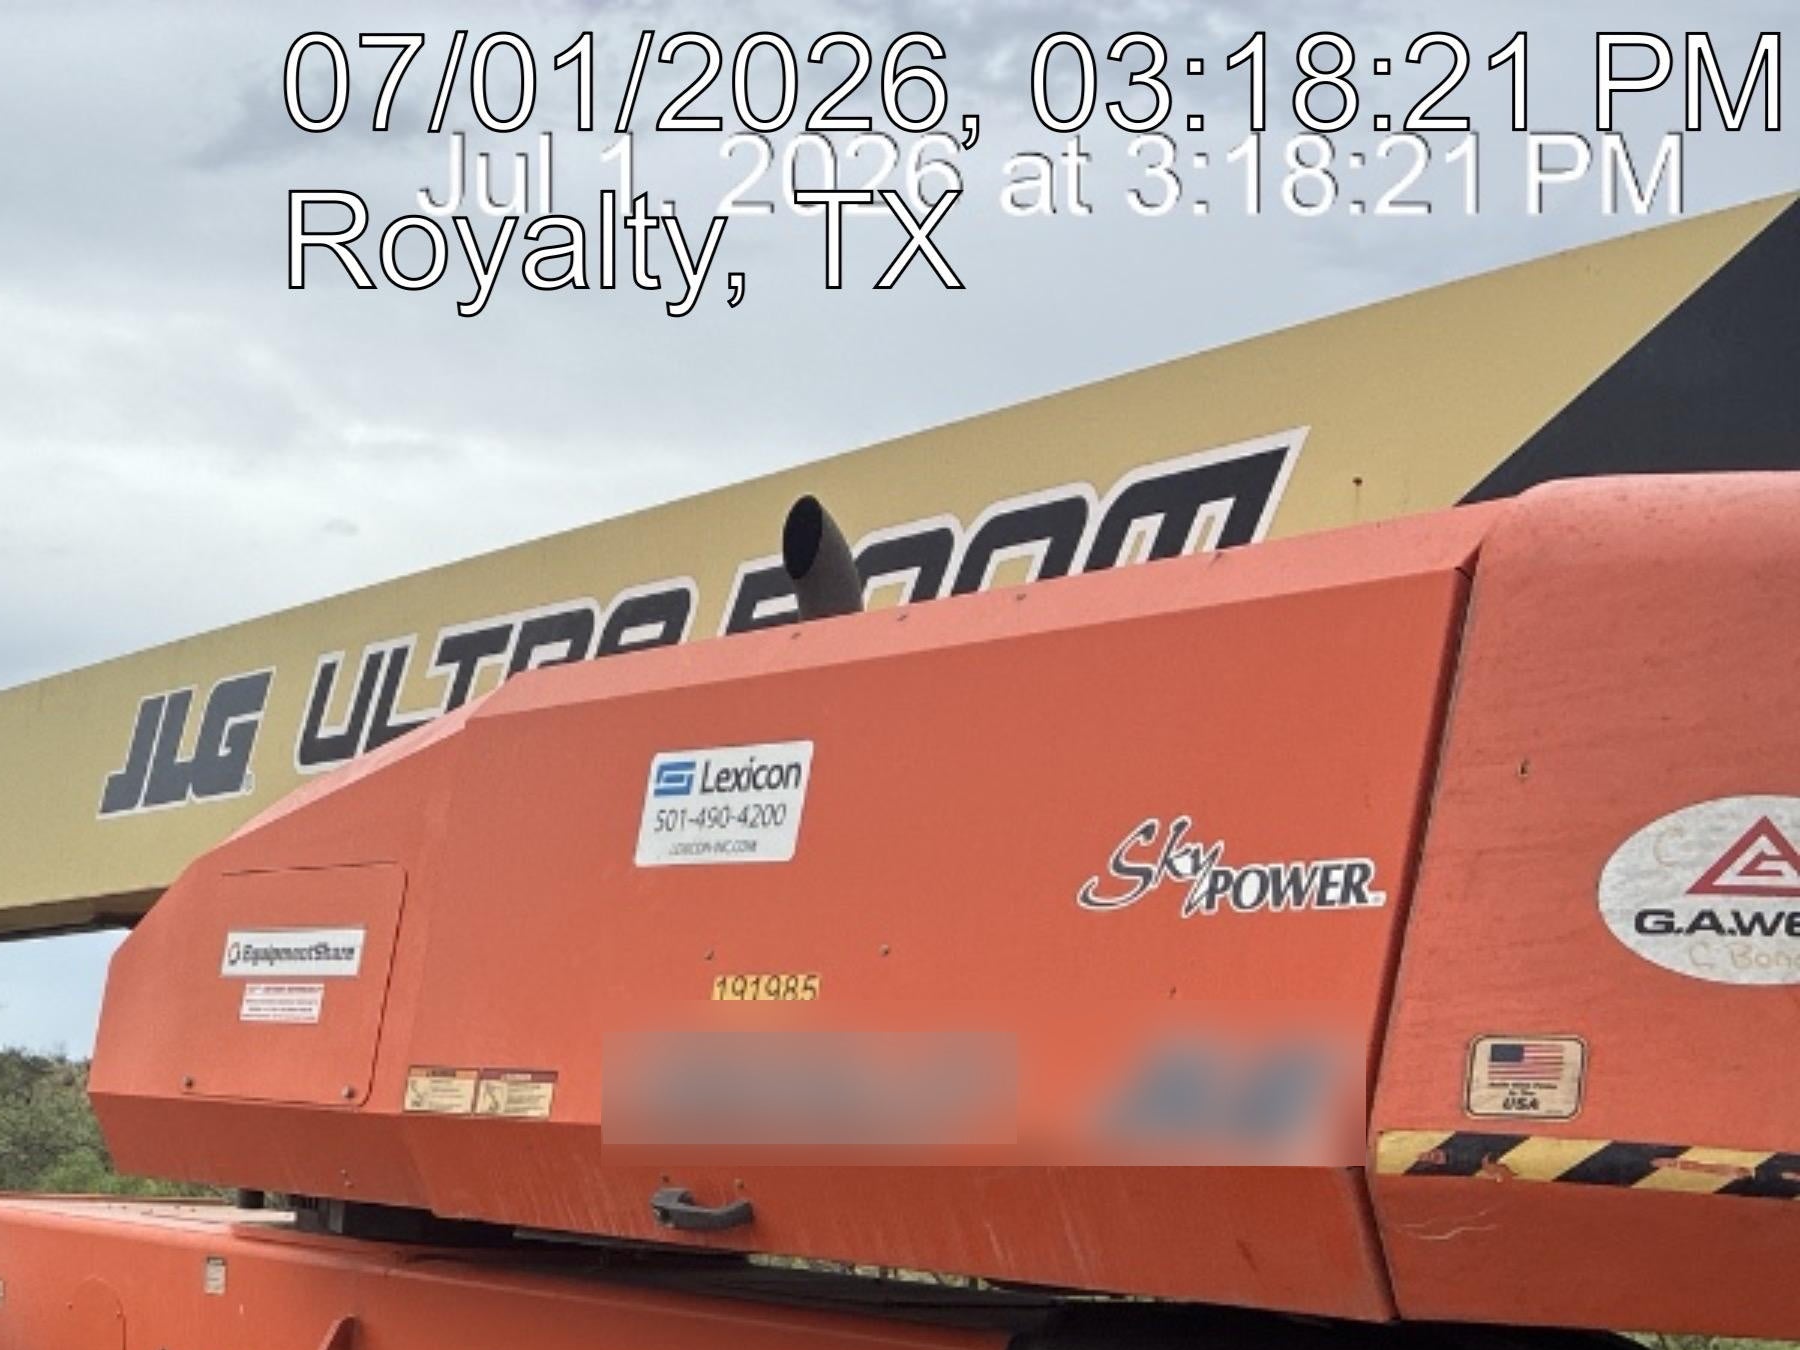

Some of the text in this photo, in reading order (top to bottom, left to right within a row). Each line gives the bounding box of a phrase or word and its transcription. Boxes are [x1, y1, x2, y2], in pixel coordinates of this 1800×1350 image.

[98, 668, 275, 817] JLG
[700, 755, 801, 794] Lexicon
[654, 803, 787, 832] 501-490-4200
[715, 974, 818, 1001] 191985
[1503, 1098, 1539, 1110] USA
